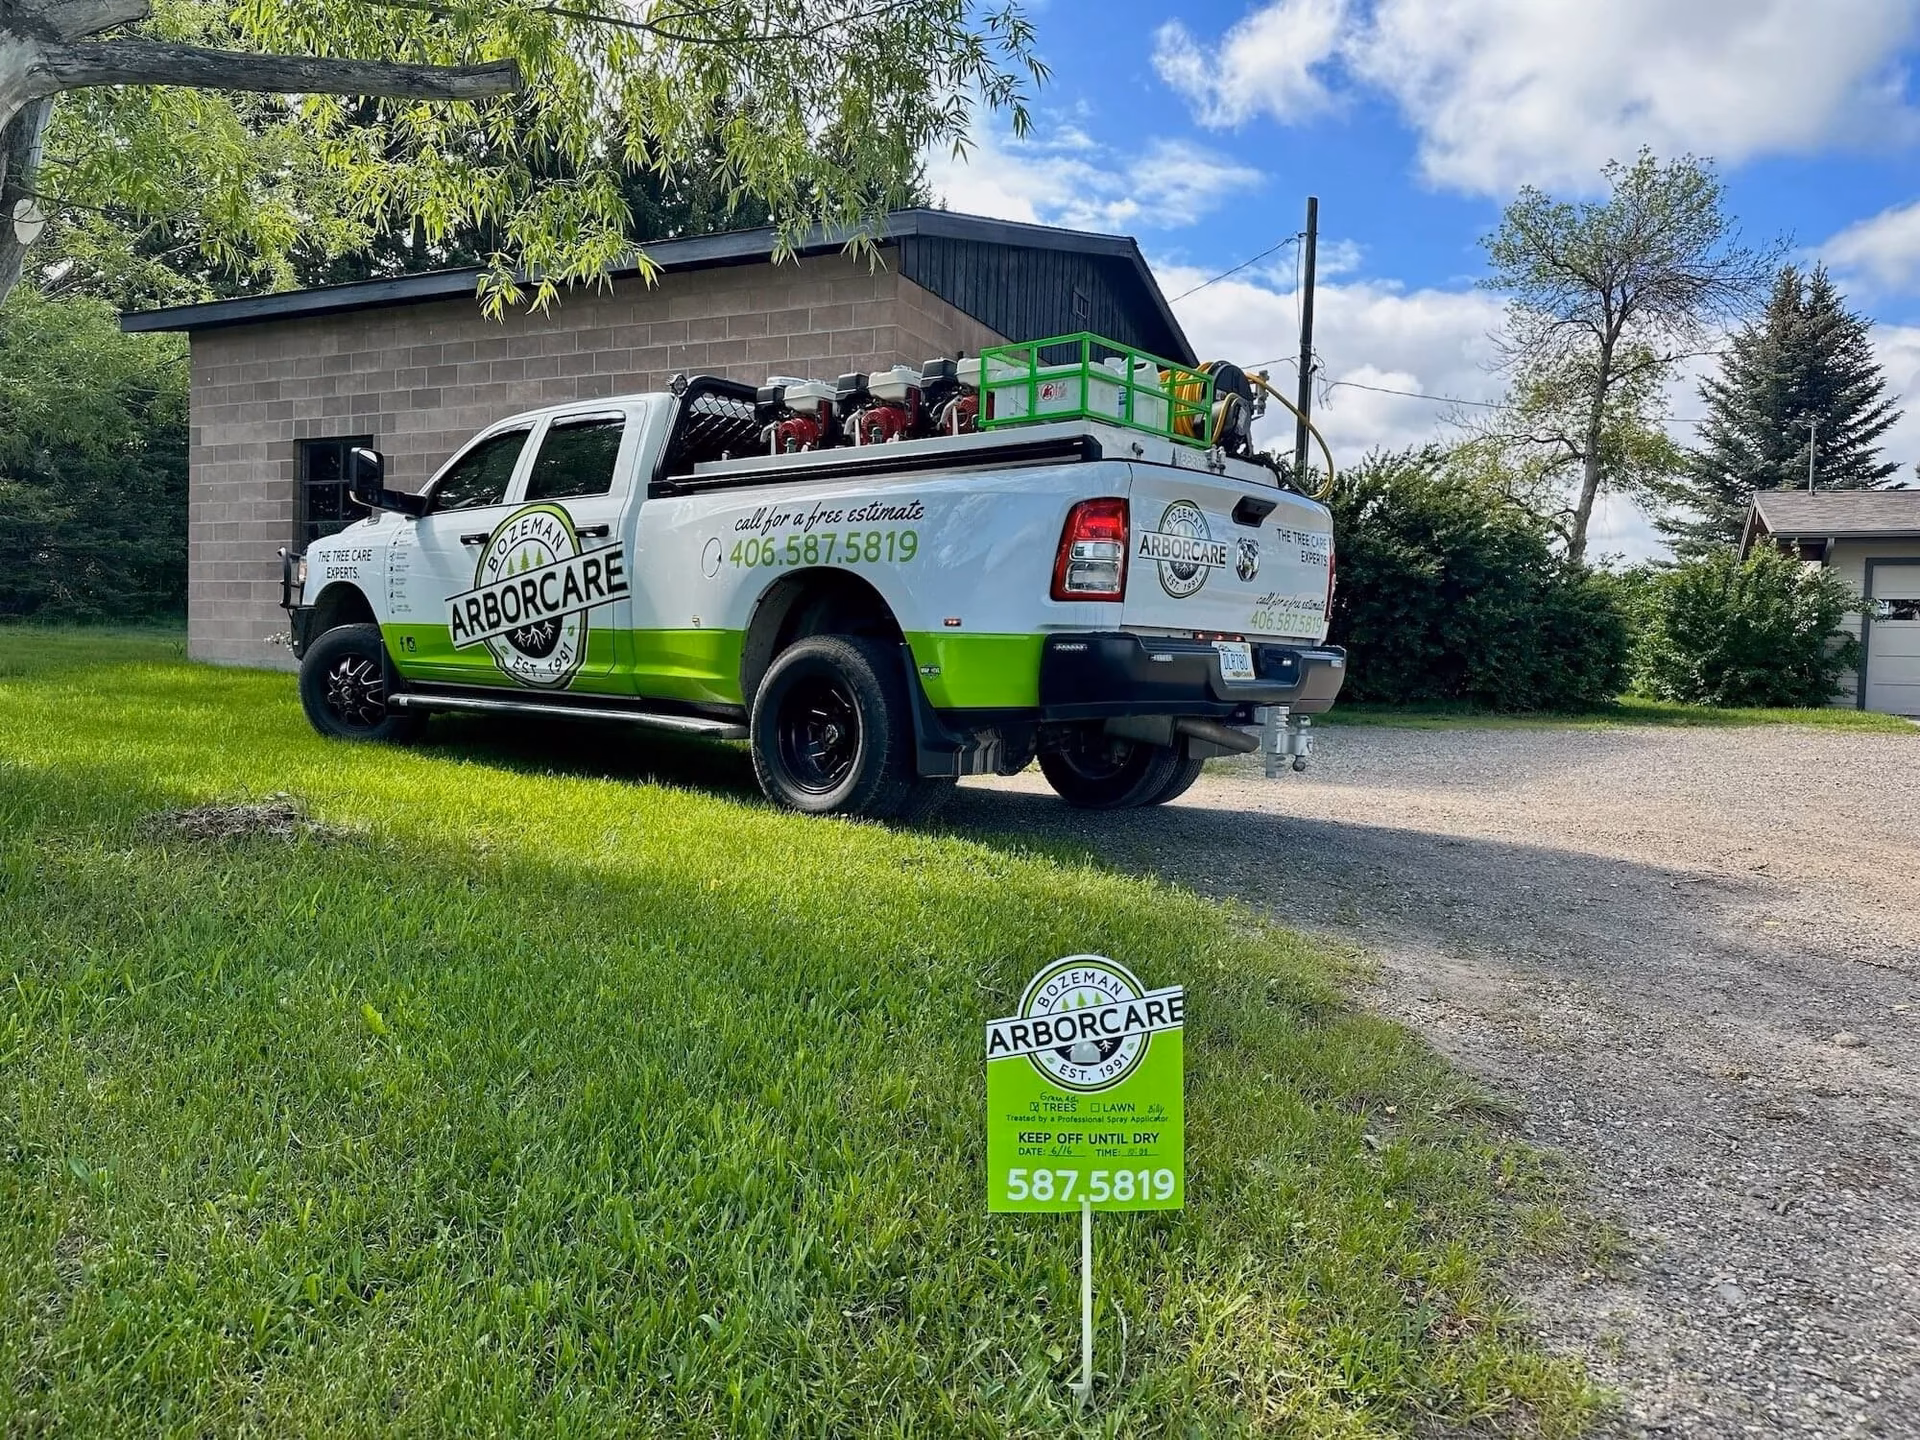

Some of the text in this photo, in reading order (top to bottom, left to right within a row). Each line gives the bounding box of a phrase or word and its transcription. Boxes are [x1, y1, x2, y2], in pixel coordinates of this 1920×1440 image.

[734, 499, 925, 536] call for a free estimate
[1166, 508, 1204, 534] BOZEMAN
[487, 517, 565, 573] BOZEMAN
[729, 530, 919, 568] 406.587.5819
[1139, 534, 1227, 565] ARBORCARE
[1276, 528, 1291, 542] THE
[1293, 532, 1310, 546] TREE
[318, 549, 373, 562] THE TREE CARE
[326, 566, 360, 579] EXPERTS.
[1166, 574, 1199, 591] EST. 1991
[452, 549, 629, 641] ARBORCARE
[1251, 610, 1322, 634] 406.587.5819
[512, 641, 573, 678] EST. 1991
[1038, 971, 1124, 1008] BOZEMAN
[988, 996, 1183, 1055] ARBORCARE
[1059, 1053, 1130, 1081] EST. 1991
[1006, 1114, 1036, 1122] Treated
[1038, 1115, 1047, 1123] by
[1058, 1115, 1104, 1123] Professional
[1107, 1116, 1127, 1124] Spray
[1131, 1115, 1168, 1124] Applicator
[1043, 1102, 1135, 1112] TREES LAWN
[1018, 1132, 1159, 1144] KEEP OFF UNTIL DRY
[1007, 1168, 1175, 1203] 587.5819
